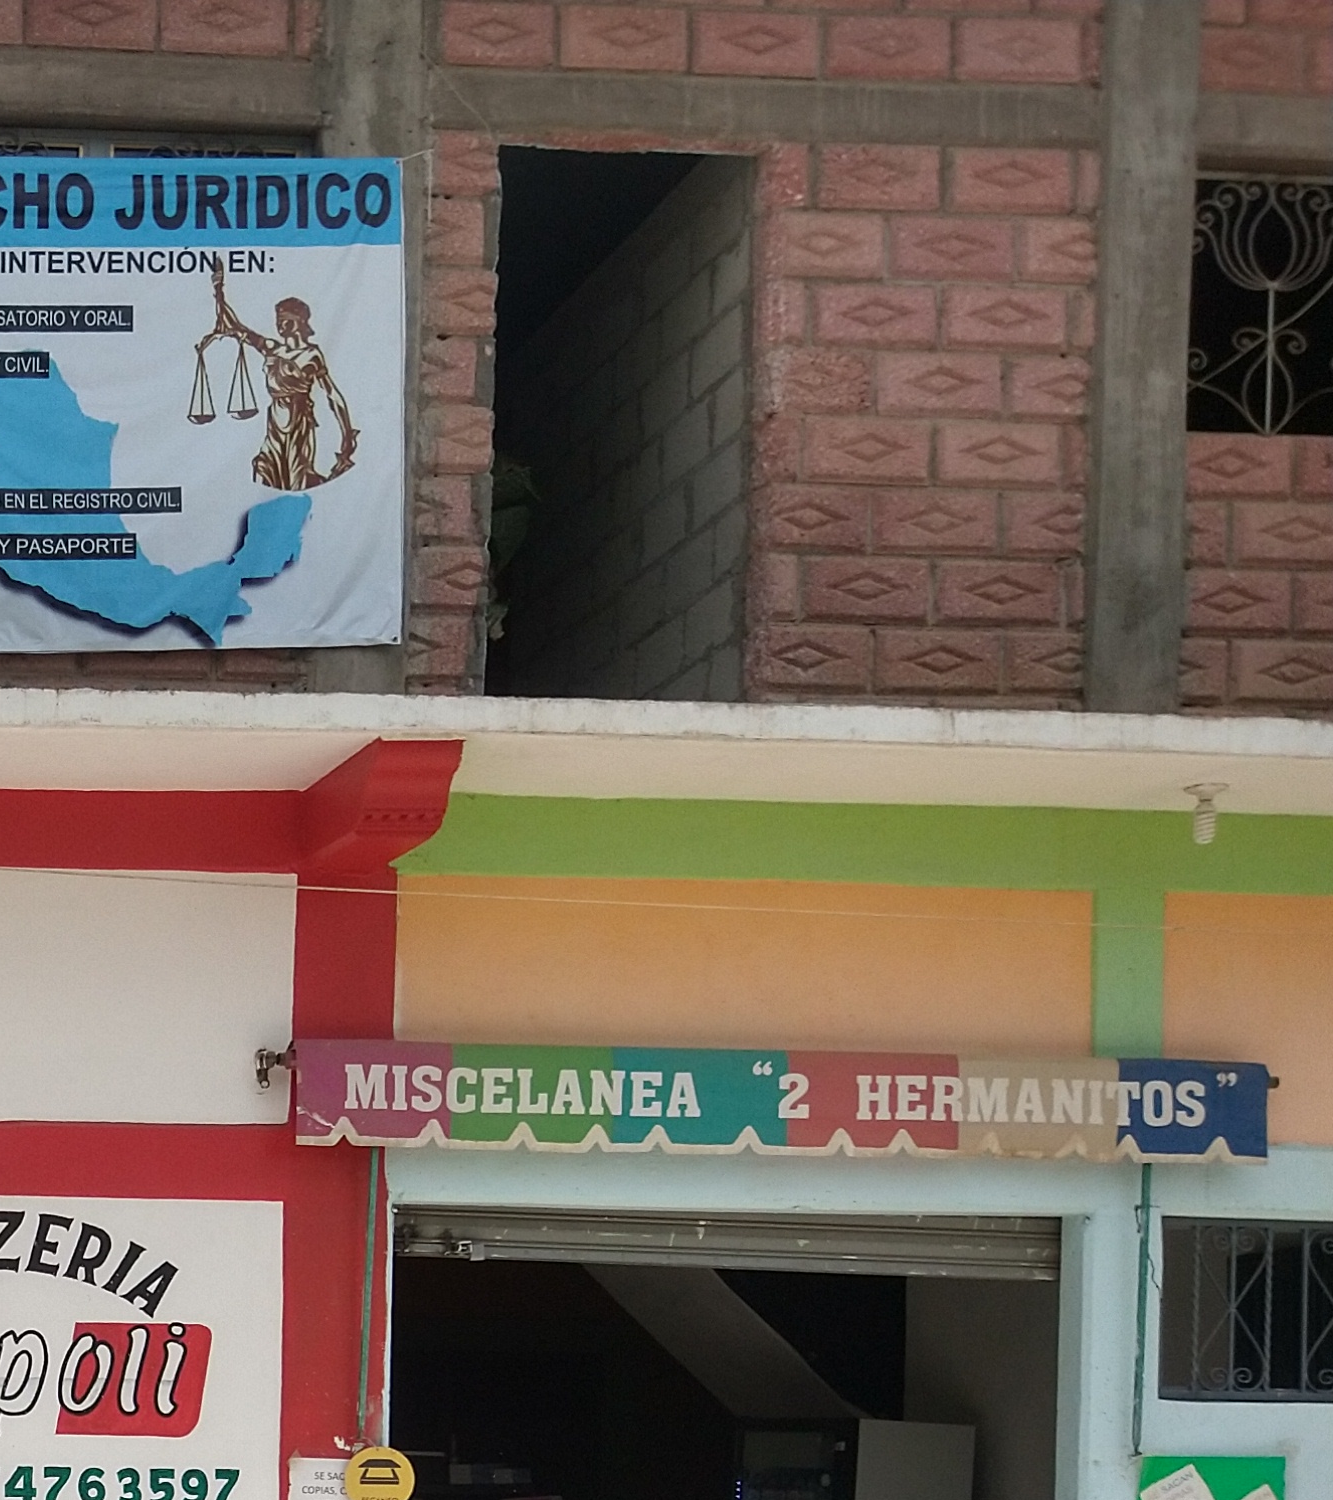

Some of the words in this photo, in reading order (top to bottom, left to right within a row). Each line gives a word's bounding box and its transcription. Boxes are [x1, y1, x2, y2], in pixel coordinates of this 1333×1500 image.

[114, 172, 392, 230] JURIDICO
[0, 246, 218, 273] INTERVENCIÓN
[229, 250, 275, 273] EN:
[69, 311, 81, 326] Y
[84, 310, 131, 327] ORAL.
[5, 356, 49, 373] CIVIL.
[5, 493, 25, 509] EN
[29, 493, 48, 509] EL
[53, 492, 133, 509] REGISTRO
[136, 492, 180, 508] CIVIL.
[16, 537, 135, 555] PASAPORTE
[344, 1063, 702, 1118] MISCELANEA
[314, 1472, 324, 1480] SE
[327, 1472, 345, 1481] SAC
